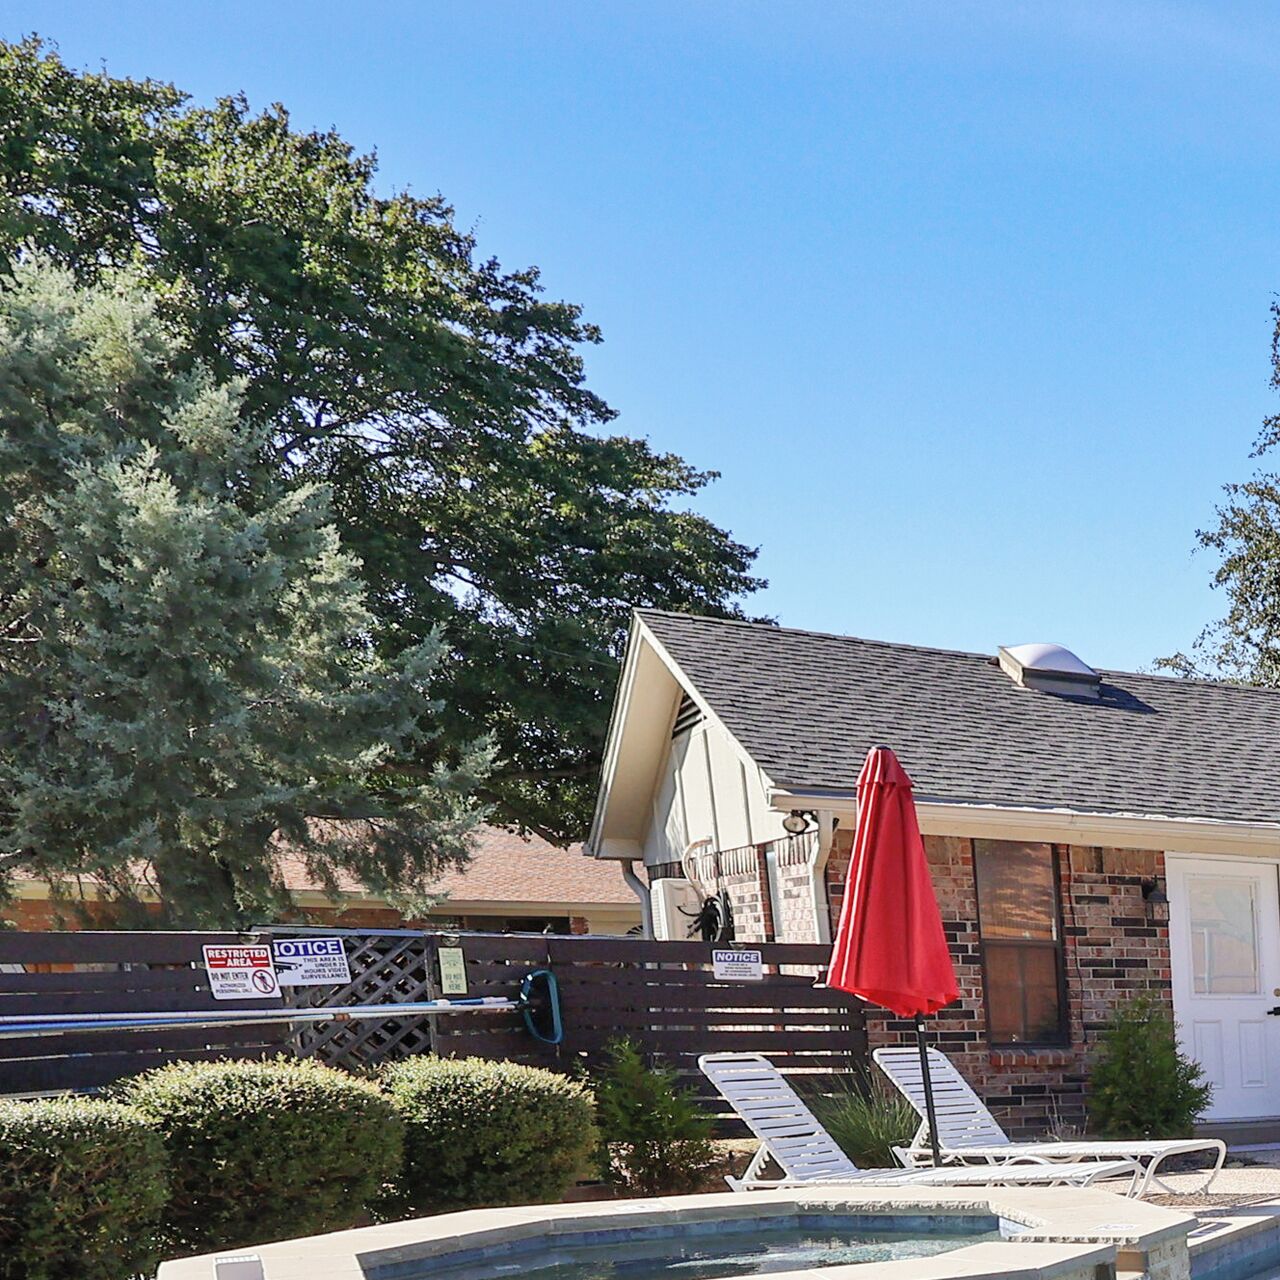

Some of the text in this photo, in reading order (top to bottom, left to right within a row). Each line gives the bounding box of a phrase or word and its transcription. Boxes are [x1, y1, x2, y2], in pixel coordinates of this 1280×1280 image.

[208, 950, 267, 958] RESTRICTED
[716, 952, 758, 961] NOTICE
[211, 971, 249, 981] DO NOT ENTER
